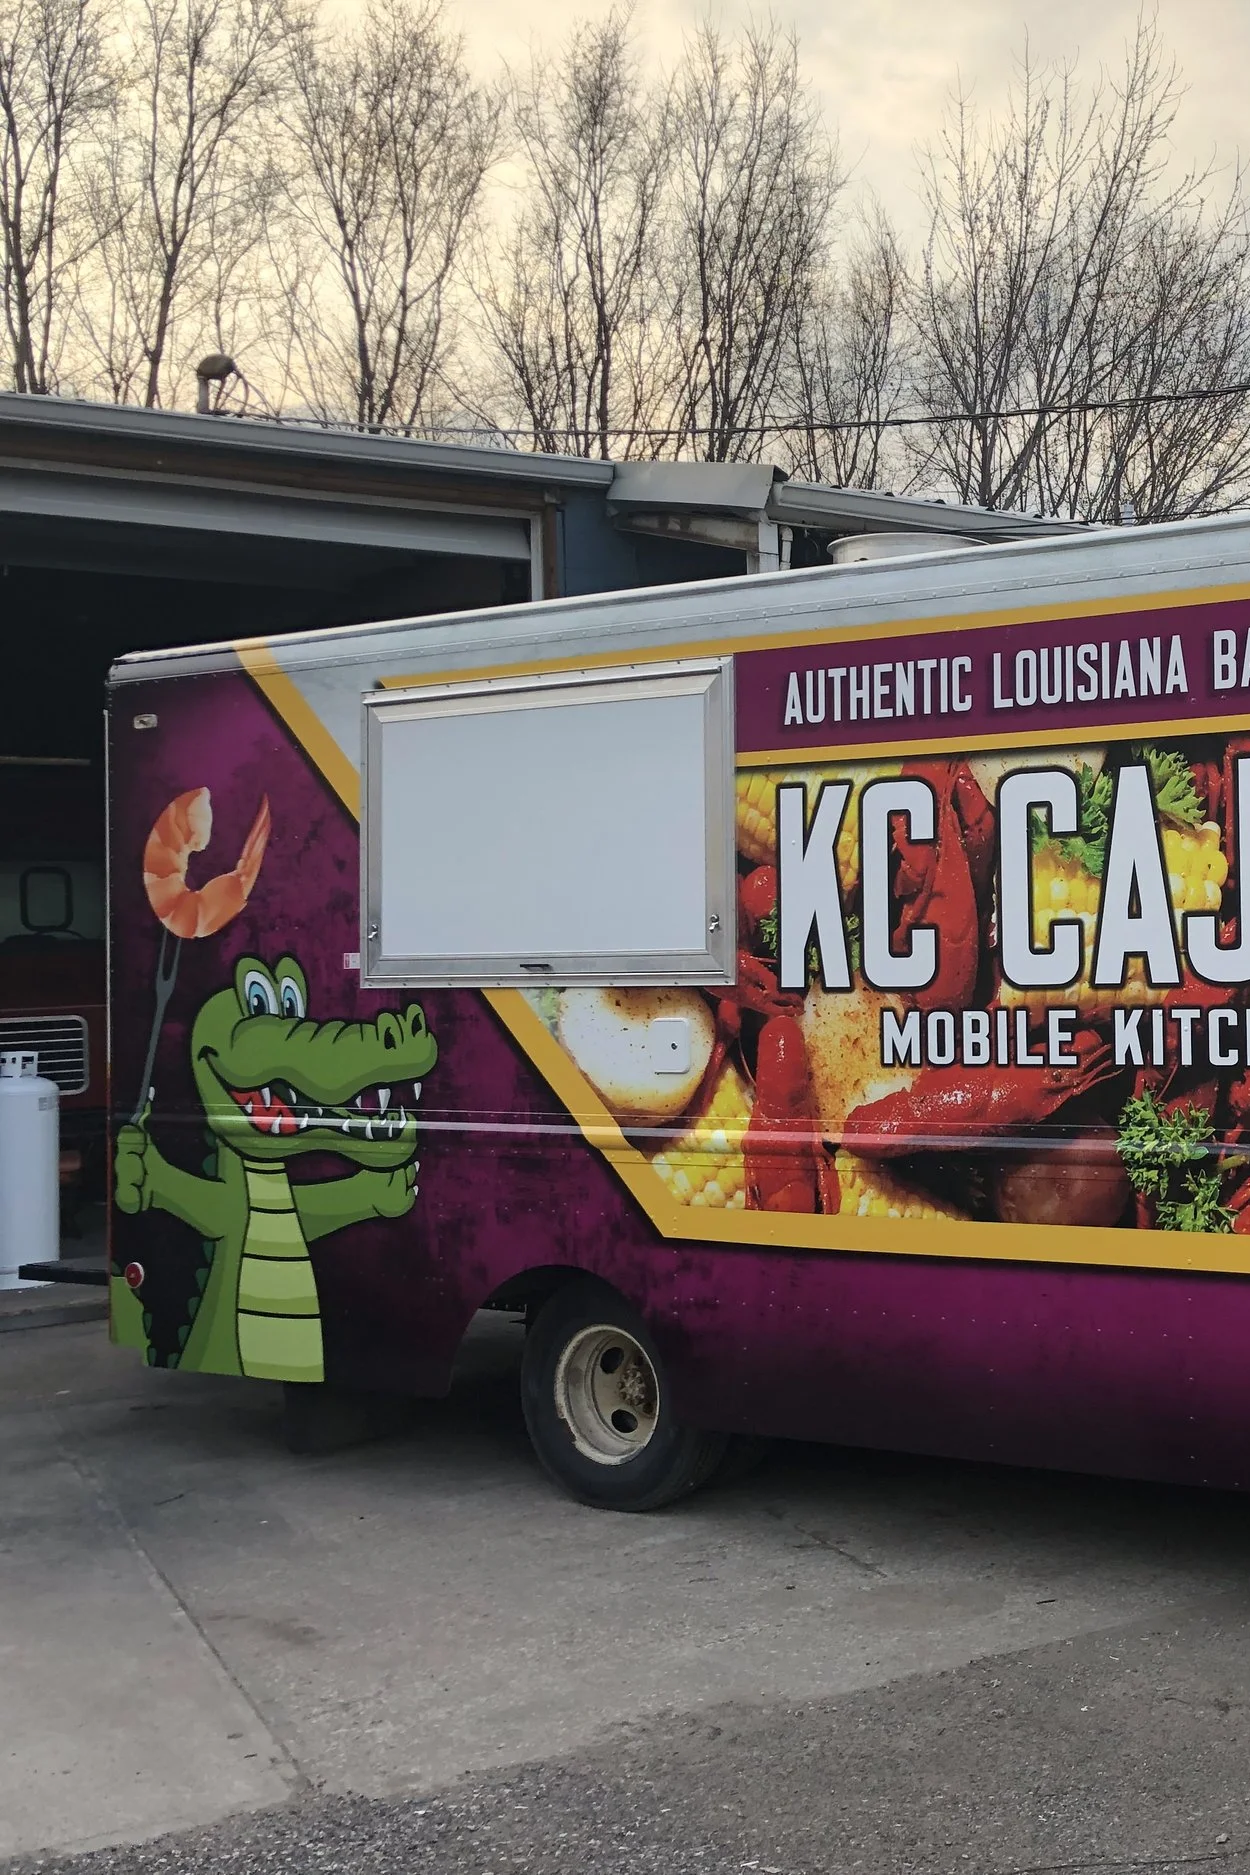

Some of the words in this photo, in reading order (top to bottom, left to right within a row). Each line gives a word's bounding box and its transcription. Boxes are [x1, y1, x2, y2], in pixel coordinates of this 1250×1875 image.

[783, 655, 973, 727] AUTHENTIC
[993, 633, 1190, 710] LOUISIANA
[778, 779, 938, 990] KC
[882, 1008, 1078, 1067] MOBILE
